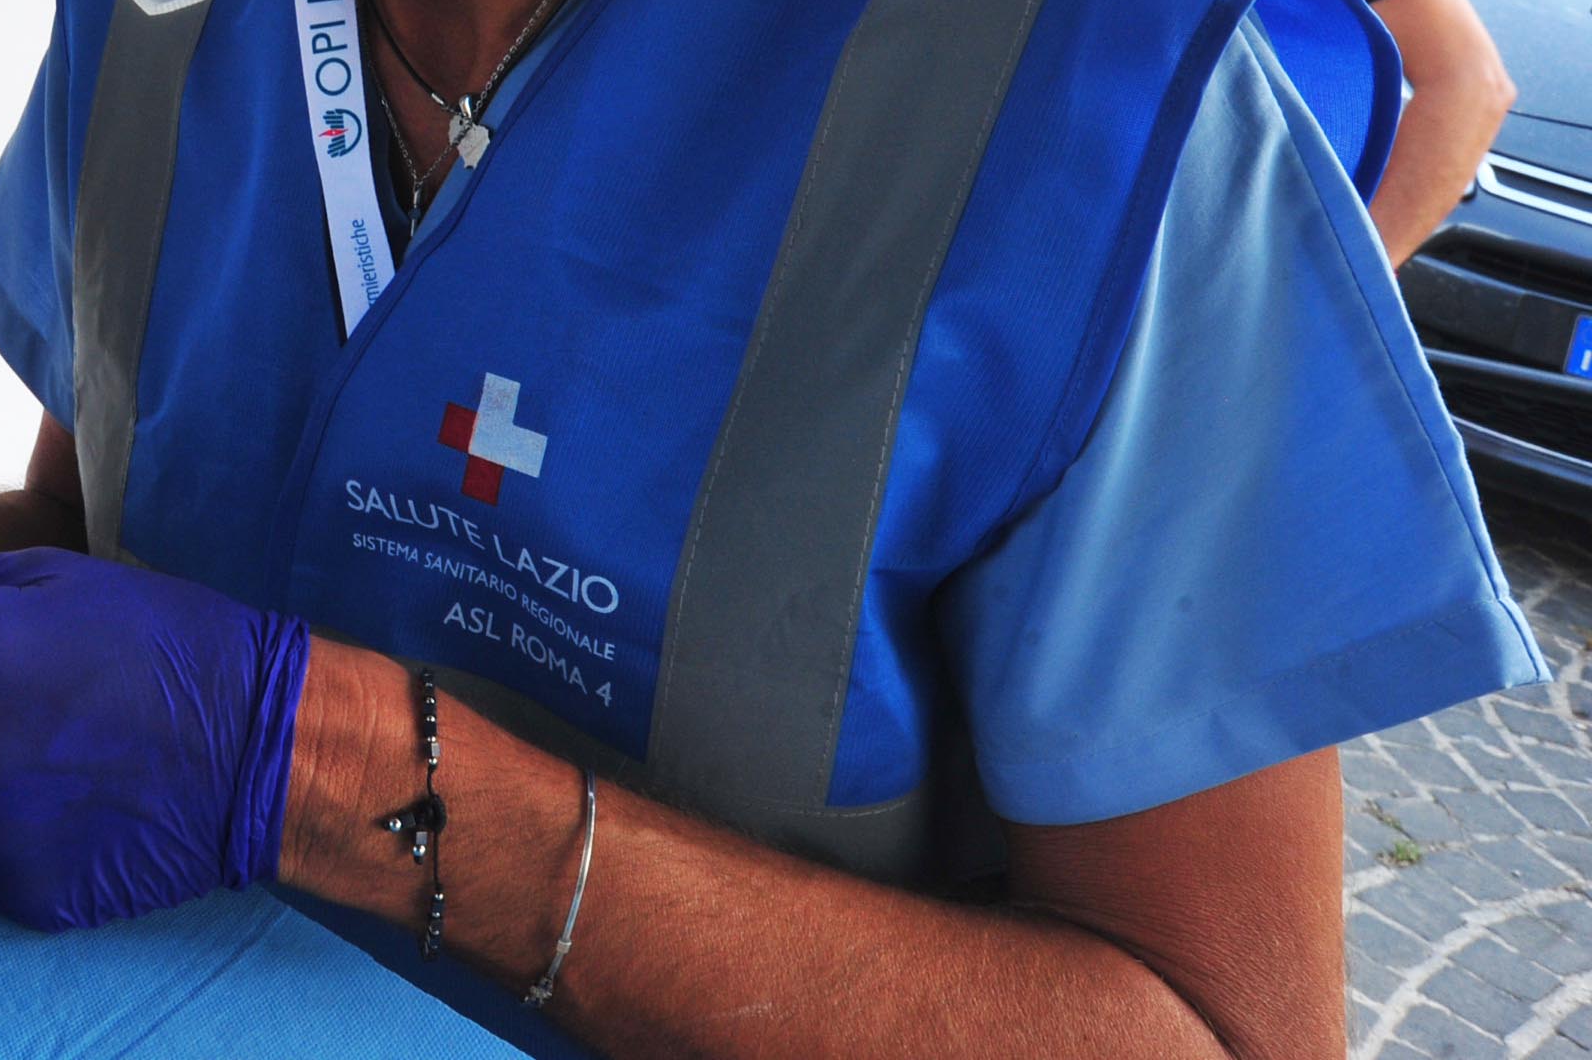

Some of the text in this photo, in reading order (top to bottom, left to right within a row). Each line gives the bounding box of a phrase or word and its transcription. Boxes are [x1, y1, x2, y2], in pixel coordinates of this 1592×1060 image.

[310, 19, 351, 96] OPI
[345, 479, 620, 614] SALUTE LAZIO
[352, 532, 616, 660] SISTEMA SANITARIO REGIONALE
[444, 603, 612, 707] ASL ROMA 4
